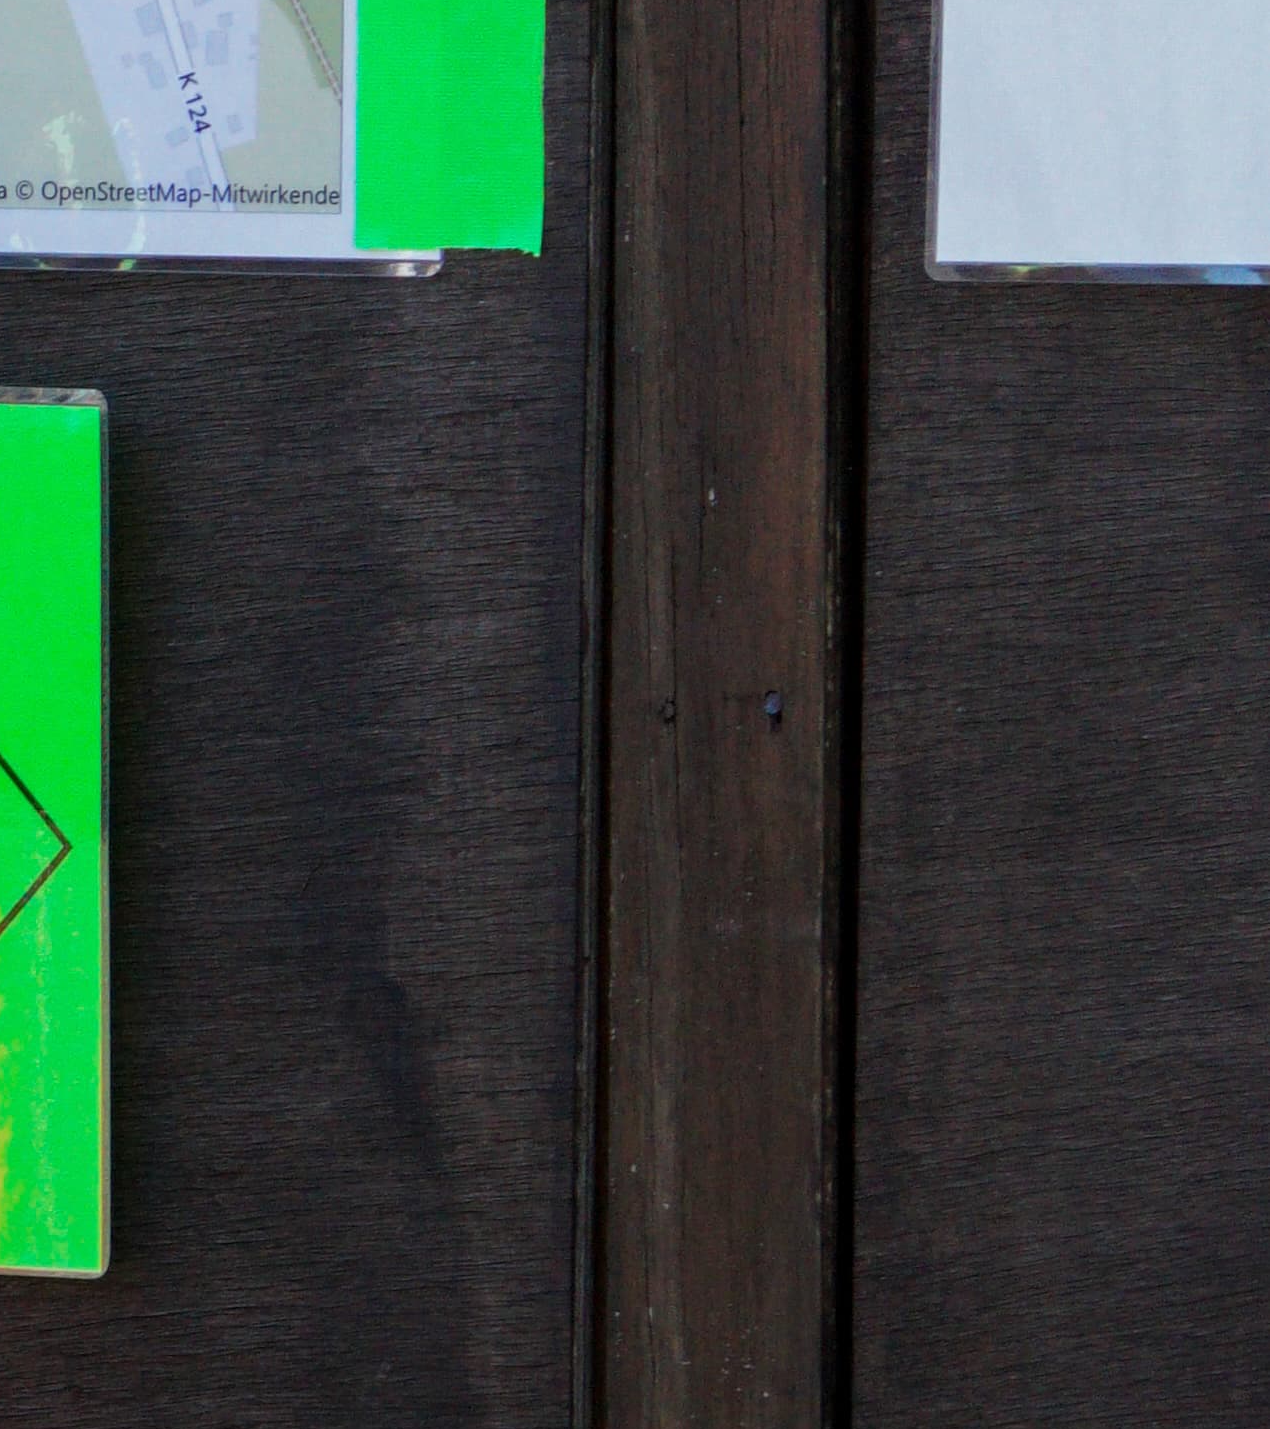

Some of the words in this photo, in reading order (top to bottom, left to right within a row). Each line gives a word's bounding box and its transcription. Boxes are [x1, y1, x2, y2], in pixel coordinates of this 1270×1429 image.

[177, 71, 199, 91] K
[185, 92, 212, 134] 124
[40, 179, 341, 208] OpenStreetMap-Mitwirkende
